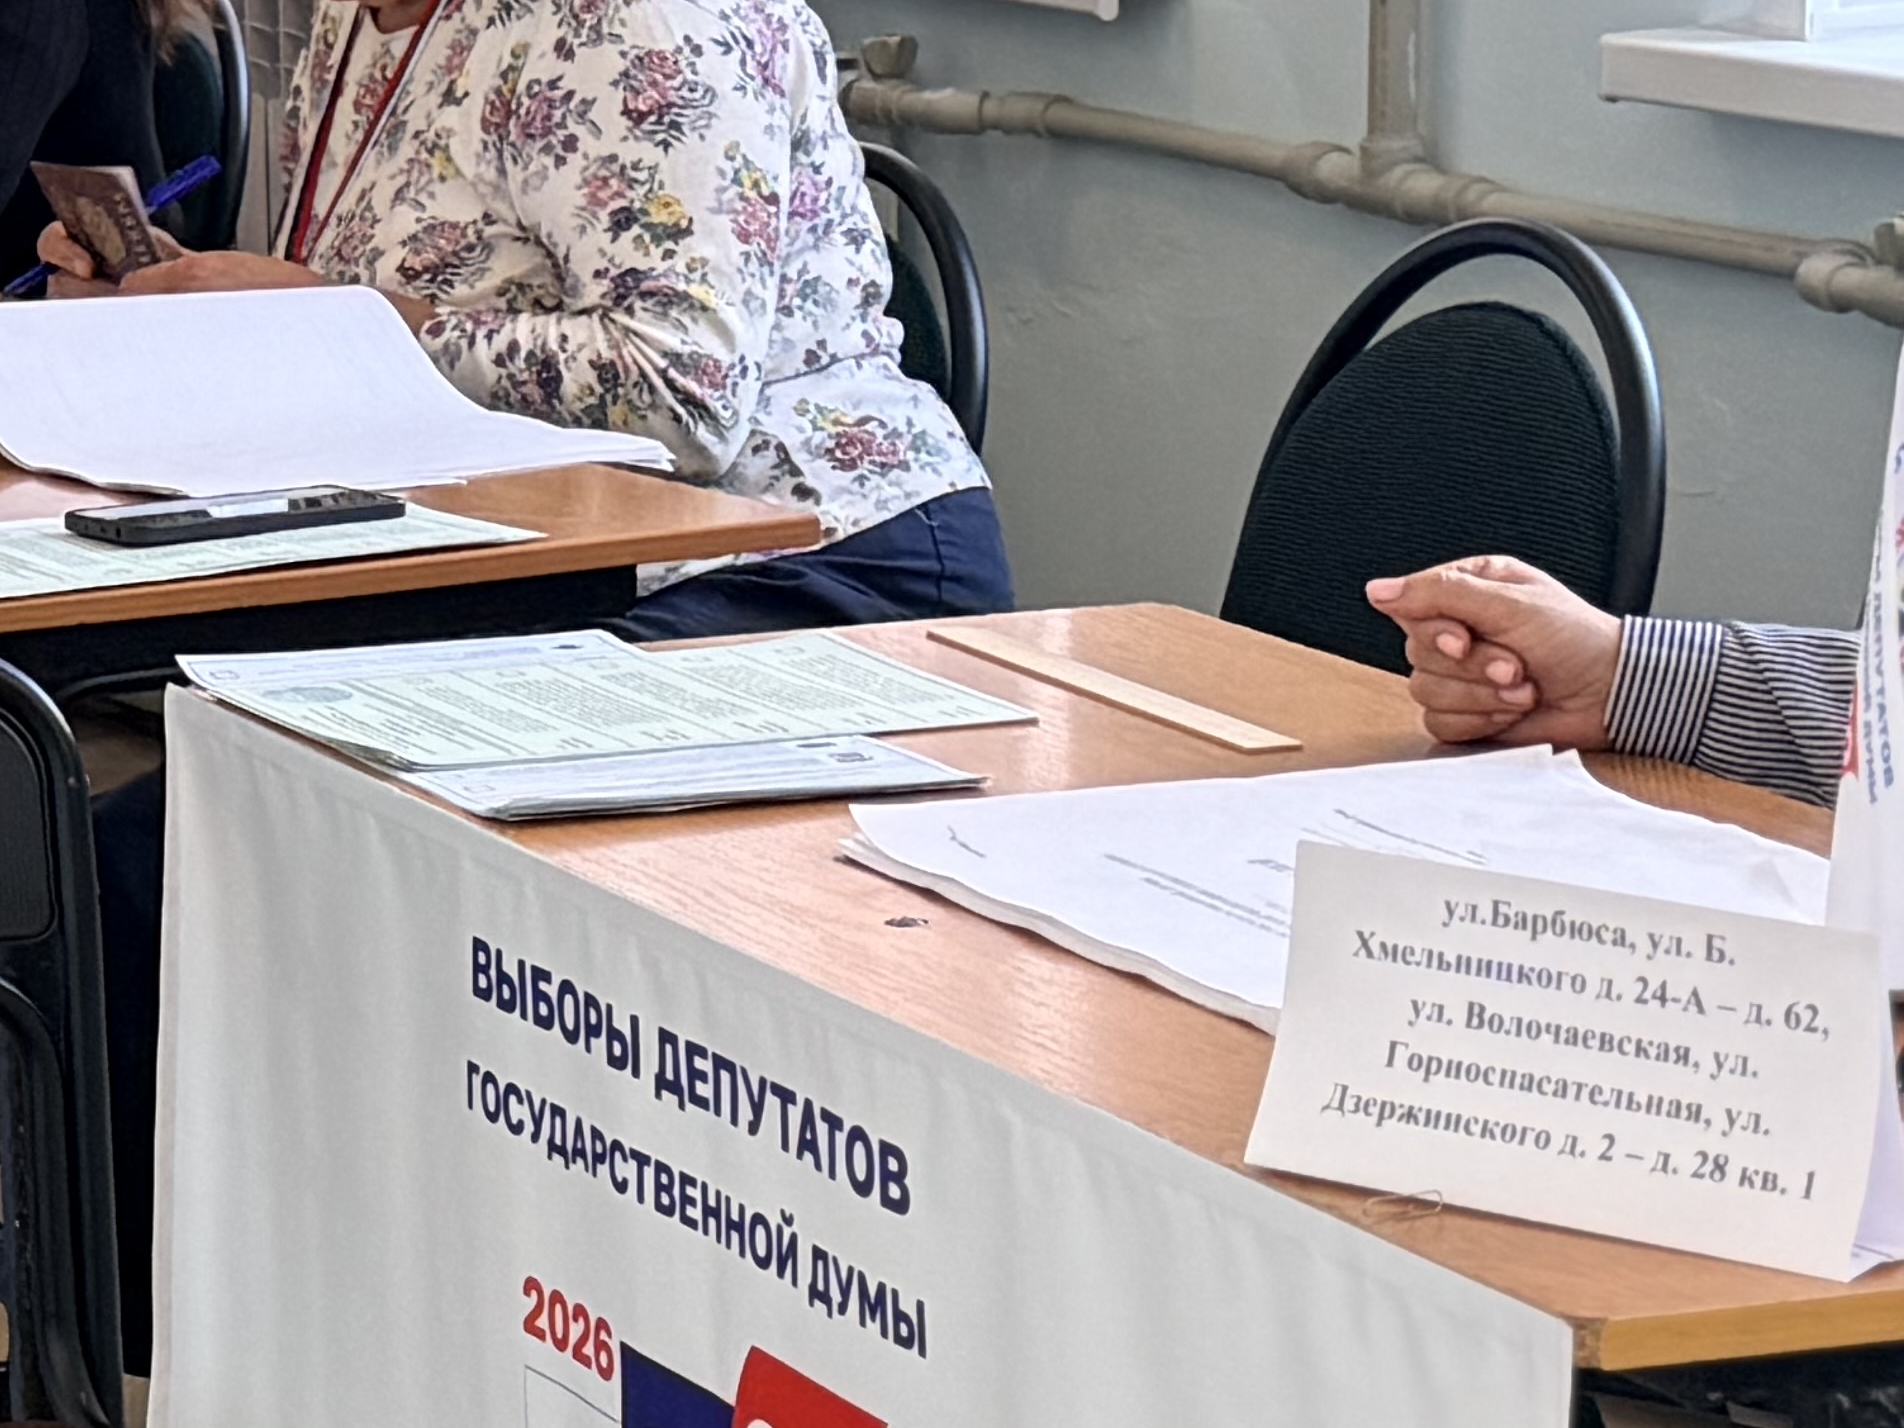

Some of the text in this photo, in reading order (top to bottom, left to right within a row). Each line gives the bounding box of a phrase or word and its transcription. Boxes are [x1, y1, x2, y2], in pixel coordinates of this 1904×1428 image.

[1351, 929, 1588, 995] Хмельницкого
[1594, 975, 1623, 1002] д.
[1632, 975, 1707, 1017] 24-А
[1743, 1001, 1773, 1027] д.
[1783, 1000, 1830, 1042] 62,
[1646, 931, 1693, 961] ул.
[1704, 932, 1736, 966] Б.
[472, 935, 912, 1217] ВЫБОРЫ ДЕПУТАТОВ
[1384, 1039, 1771, 1138] Горноспасательная, ул.
[1406, 997, 1759, 1081] ул. Волочаевская, ул.
[1320, 1082, 1552, 1152] Дзержинского
[1556, 1133, 1587, 1159] д.
[1596, 1132, 1617, 1163] 2
[1649, 1150, 1680, 1176] д.
[1689, 1149, 1730, 1185] 28
[1737, 1164, 1788, 1196] кв.
[1800, 1169, 1818, 1202] 1
[466, 1059, 927, 1360] ГОСУДАРСТВЕННОЙ ДУМЫ
[522, 1275, 615, 1382] 2026
